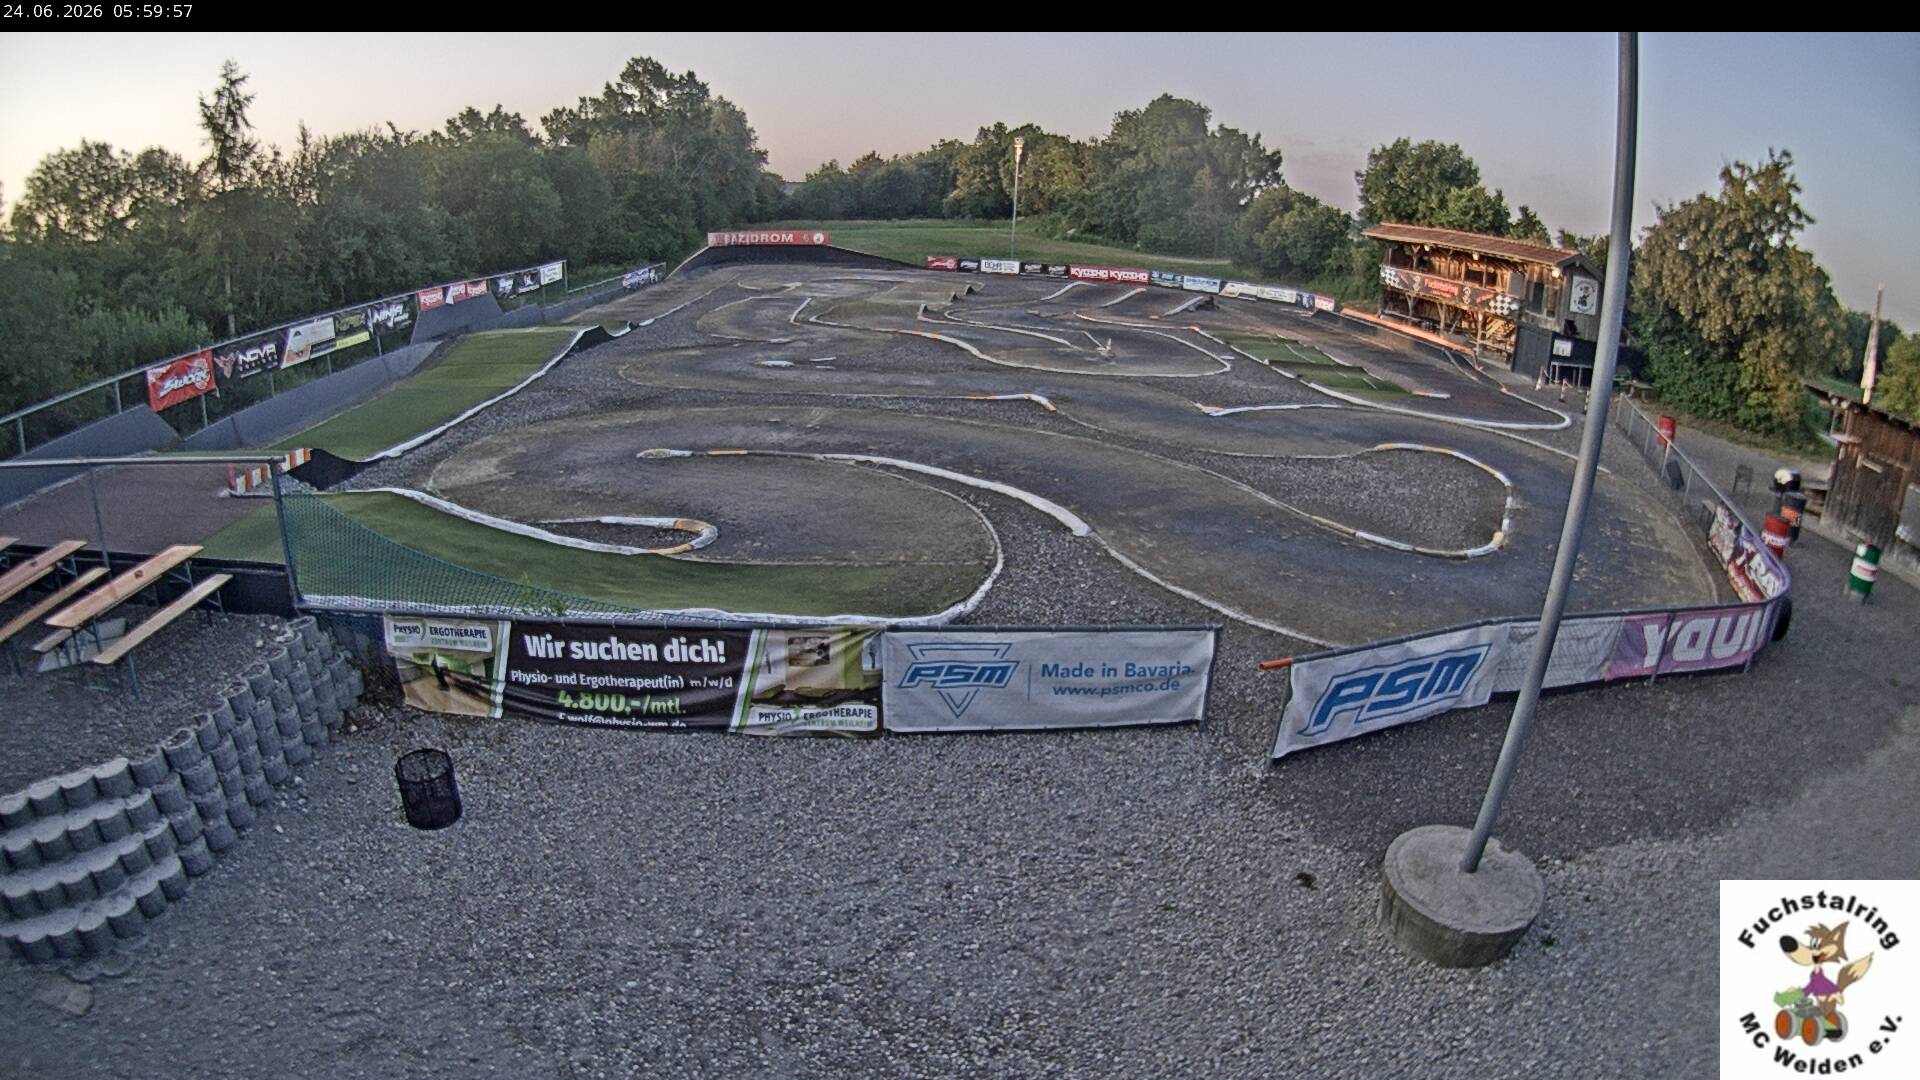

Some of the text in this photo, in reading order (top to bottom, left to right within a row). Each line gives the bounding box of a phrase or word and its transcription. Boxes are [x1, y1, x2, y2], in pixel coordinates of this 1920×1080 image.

[1070, 267, 1109, 279] KYOSHO
[1109, 269, 1149, 282] KYOSHO
[373, 303, 404, 327] NINJA
[429, 626, 487, 639] ERGOTHERAPIE
[524, 633, 727, 664] Wir suchen dich!
[511, 669, 733, 690] Physio- und Ergotherapeut(in) m/w/d
[905, 664, 1014, 686] PSM
[1041, 662, 1095, 679] Made
[1102, 661, 1118, 678] in
[1053, 678, 1181, 698] www.psmco.de
[1312, 651, 1483, 728] PSM
[758, 708, 873, 722] PHYSIO ERGOTHERAPIE
